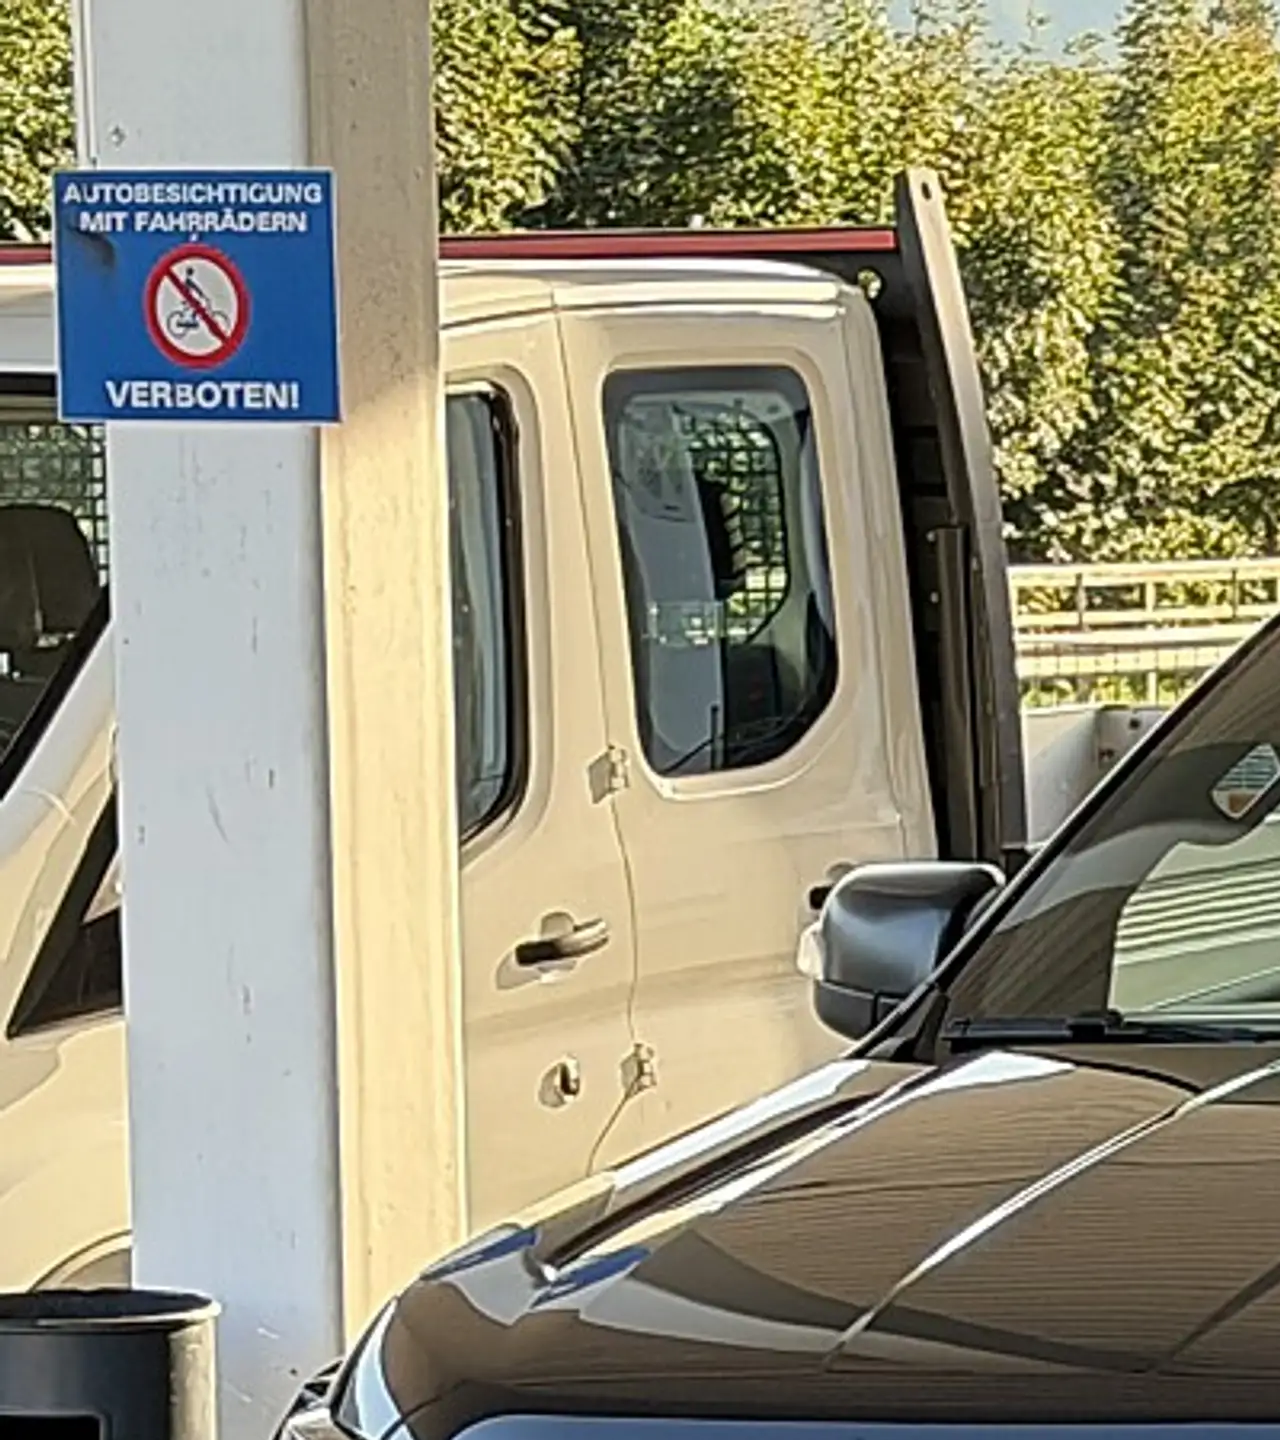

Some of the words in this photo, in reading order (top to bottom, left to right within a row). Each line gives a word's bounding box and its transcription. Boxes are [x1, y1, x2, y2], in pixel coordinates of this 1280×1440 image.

[62, 182, 323, 204] AUTOBESICHTIGUNG
[79, 211, 128, 232] MIT
[134, 208, 308, 232] FAHRRÄDERN
[104, 380, 300, 409] VERBOTEN!
